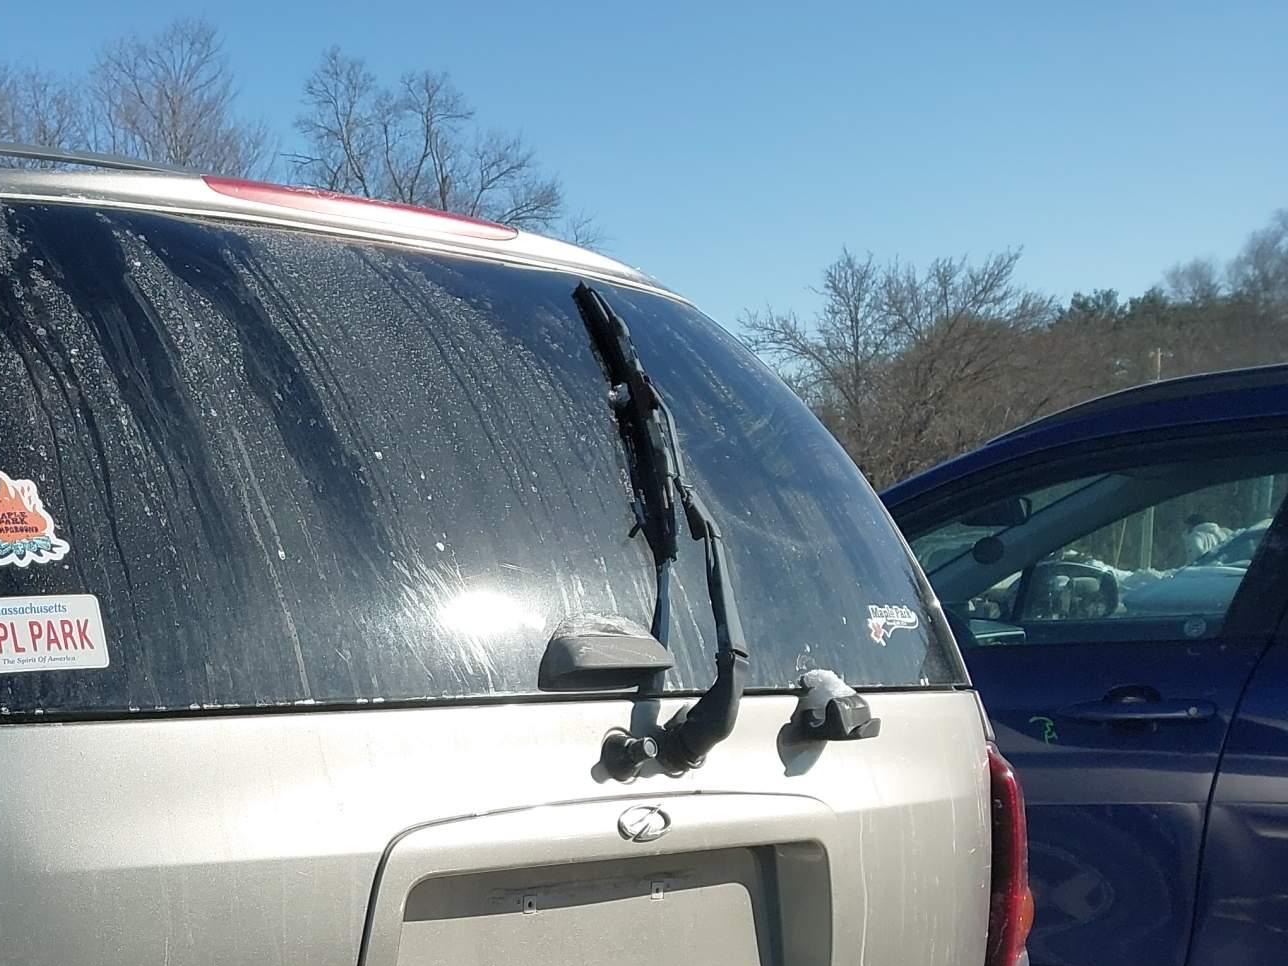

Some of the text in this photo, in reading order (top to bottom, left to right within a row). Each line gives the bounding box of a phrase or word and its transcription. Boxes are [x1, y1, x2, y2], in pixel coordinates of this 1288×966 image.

[28, 618, 95, 652] PARK
[3, 655, 76, 665] The Spirit Of America
